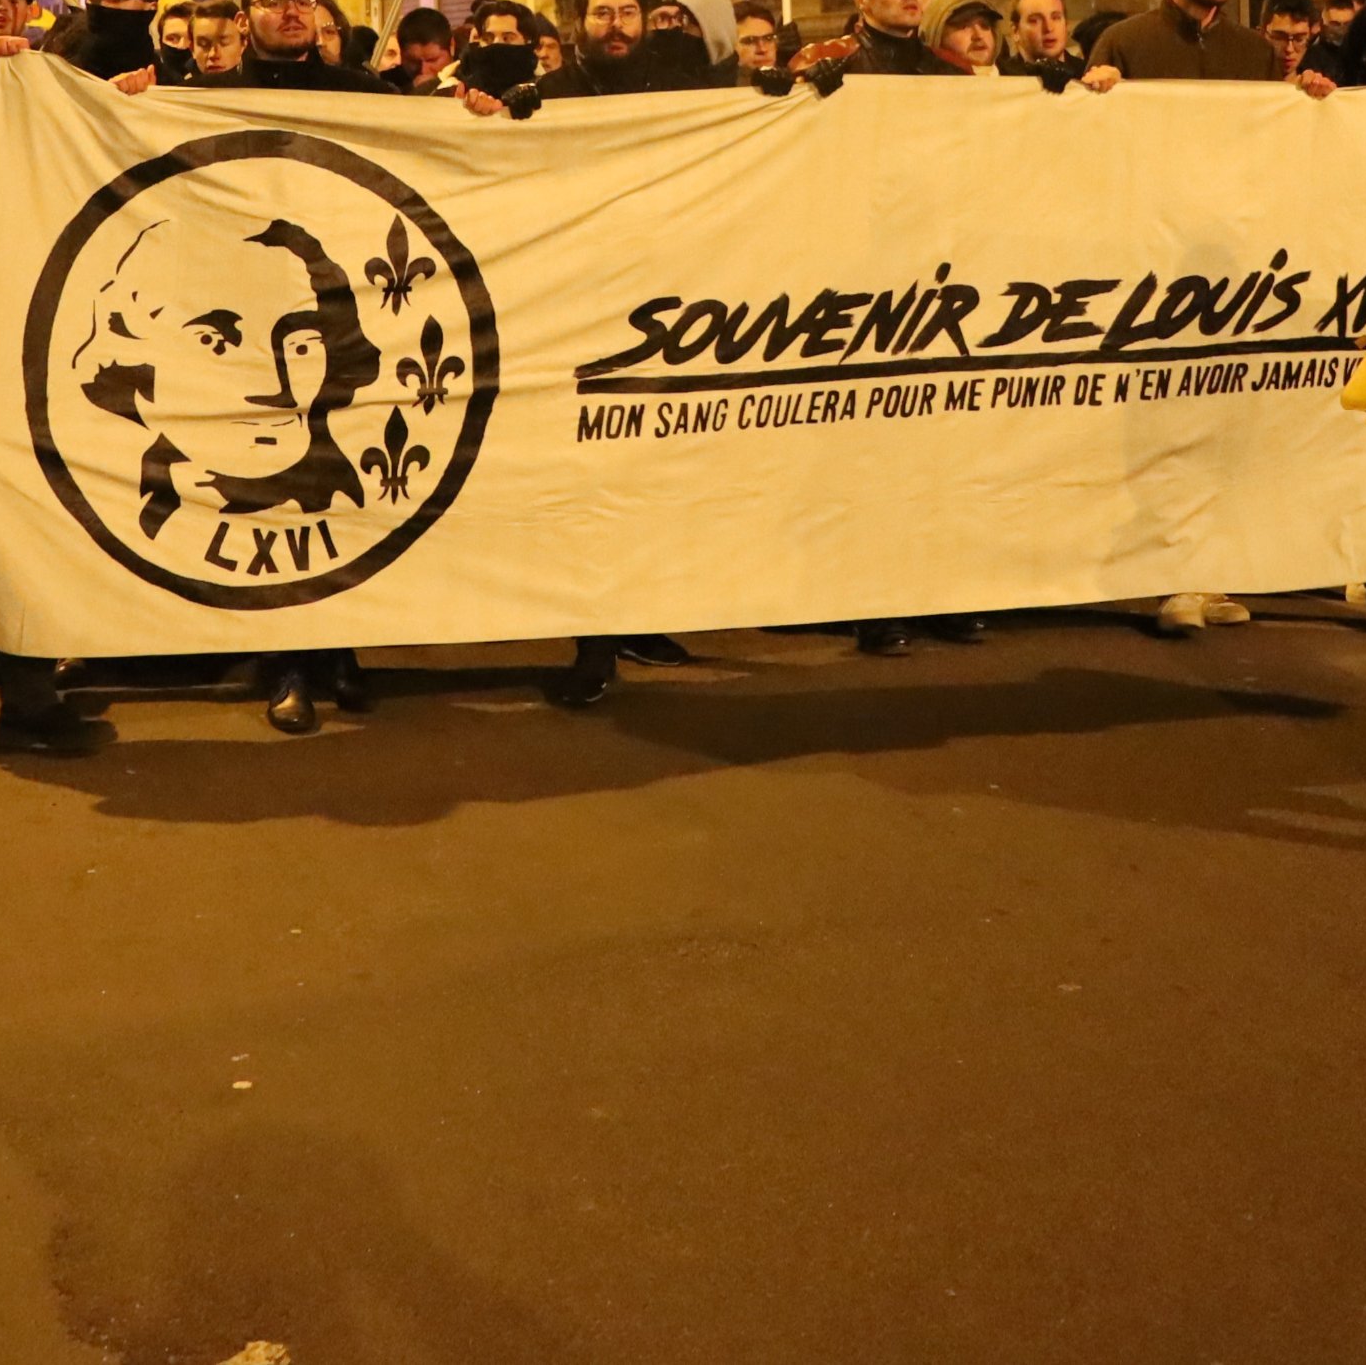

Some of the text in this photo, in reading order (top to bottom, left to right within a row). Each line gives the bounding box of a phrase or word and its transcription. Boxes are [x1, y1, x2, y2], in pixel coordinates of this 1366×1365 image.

[976, 277, 1123, 348] DE
[576, 402, 646, 442] MON
[654, 398, 729, 439] SANG
[737, 389, 856, 430] COULERA
[865, 382, 938, 419] POUR
[943, 377, 983, 412] ME
[990, 374, 1067, 409] PUNIR
[1073, 372, 1106, 406] DE
[1113, 367, 1172, 404] N'EN
[1176, 361, 1250, 398] AVOIR
[1250, 355, 1339, 394] JAMAIS
[203, 518, 339, 576] LXVI
